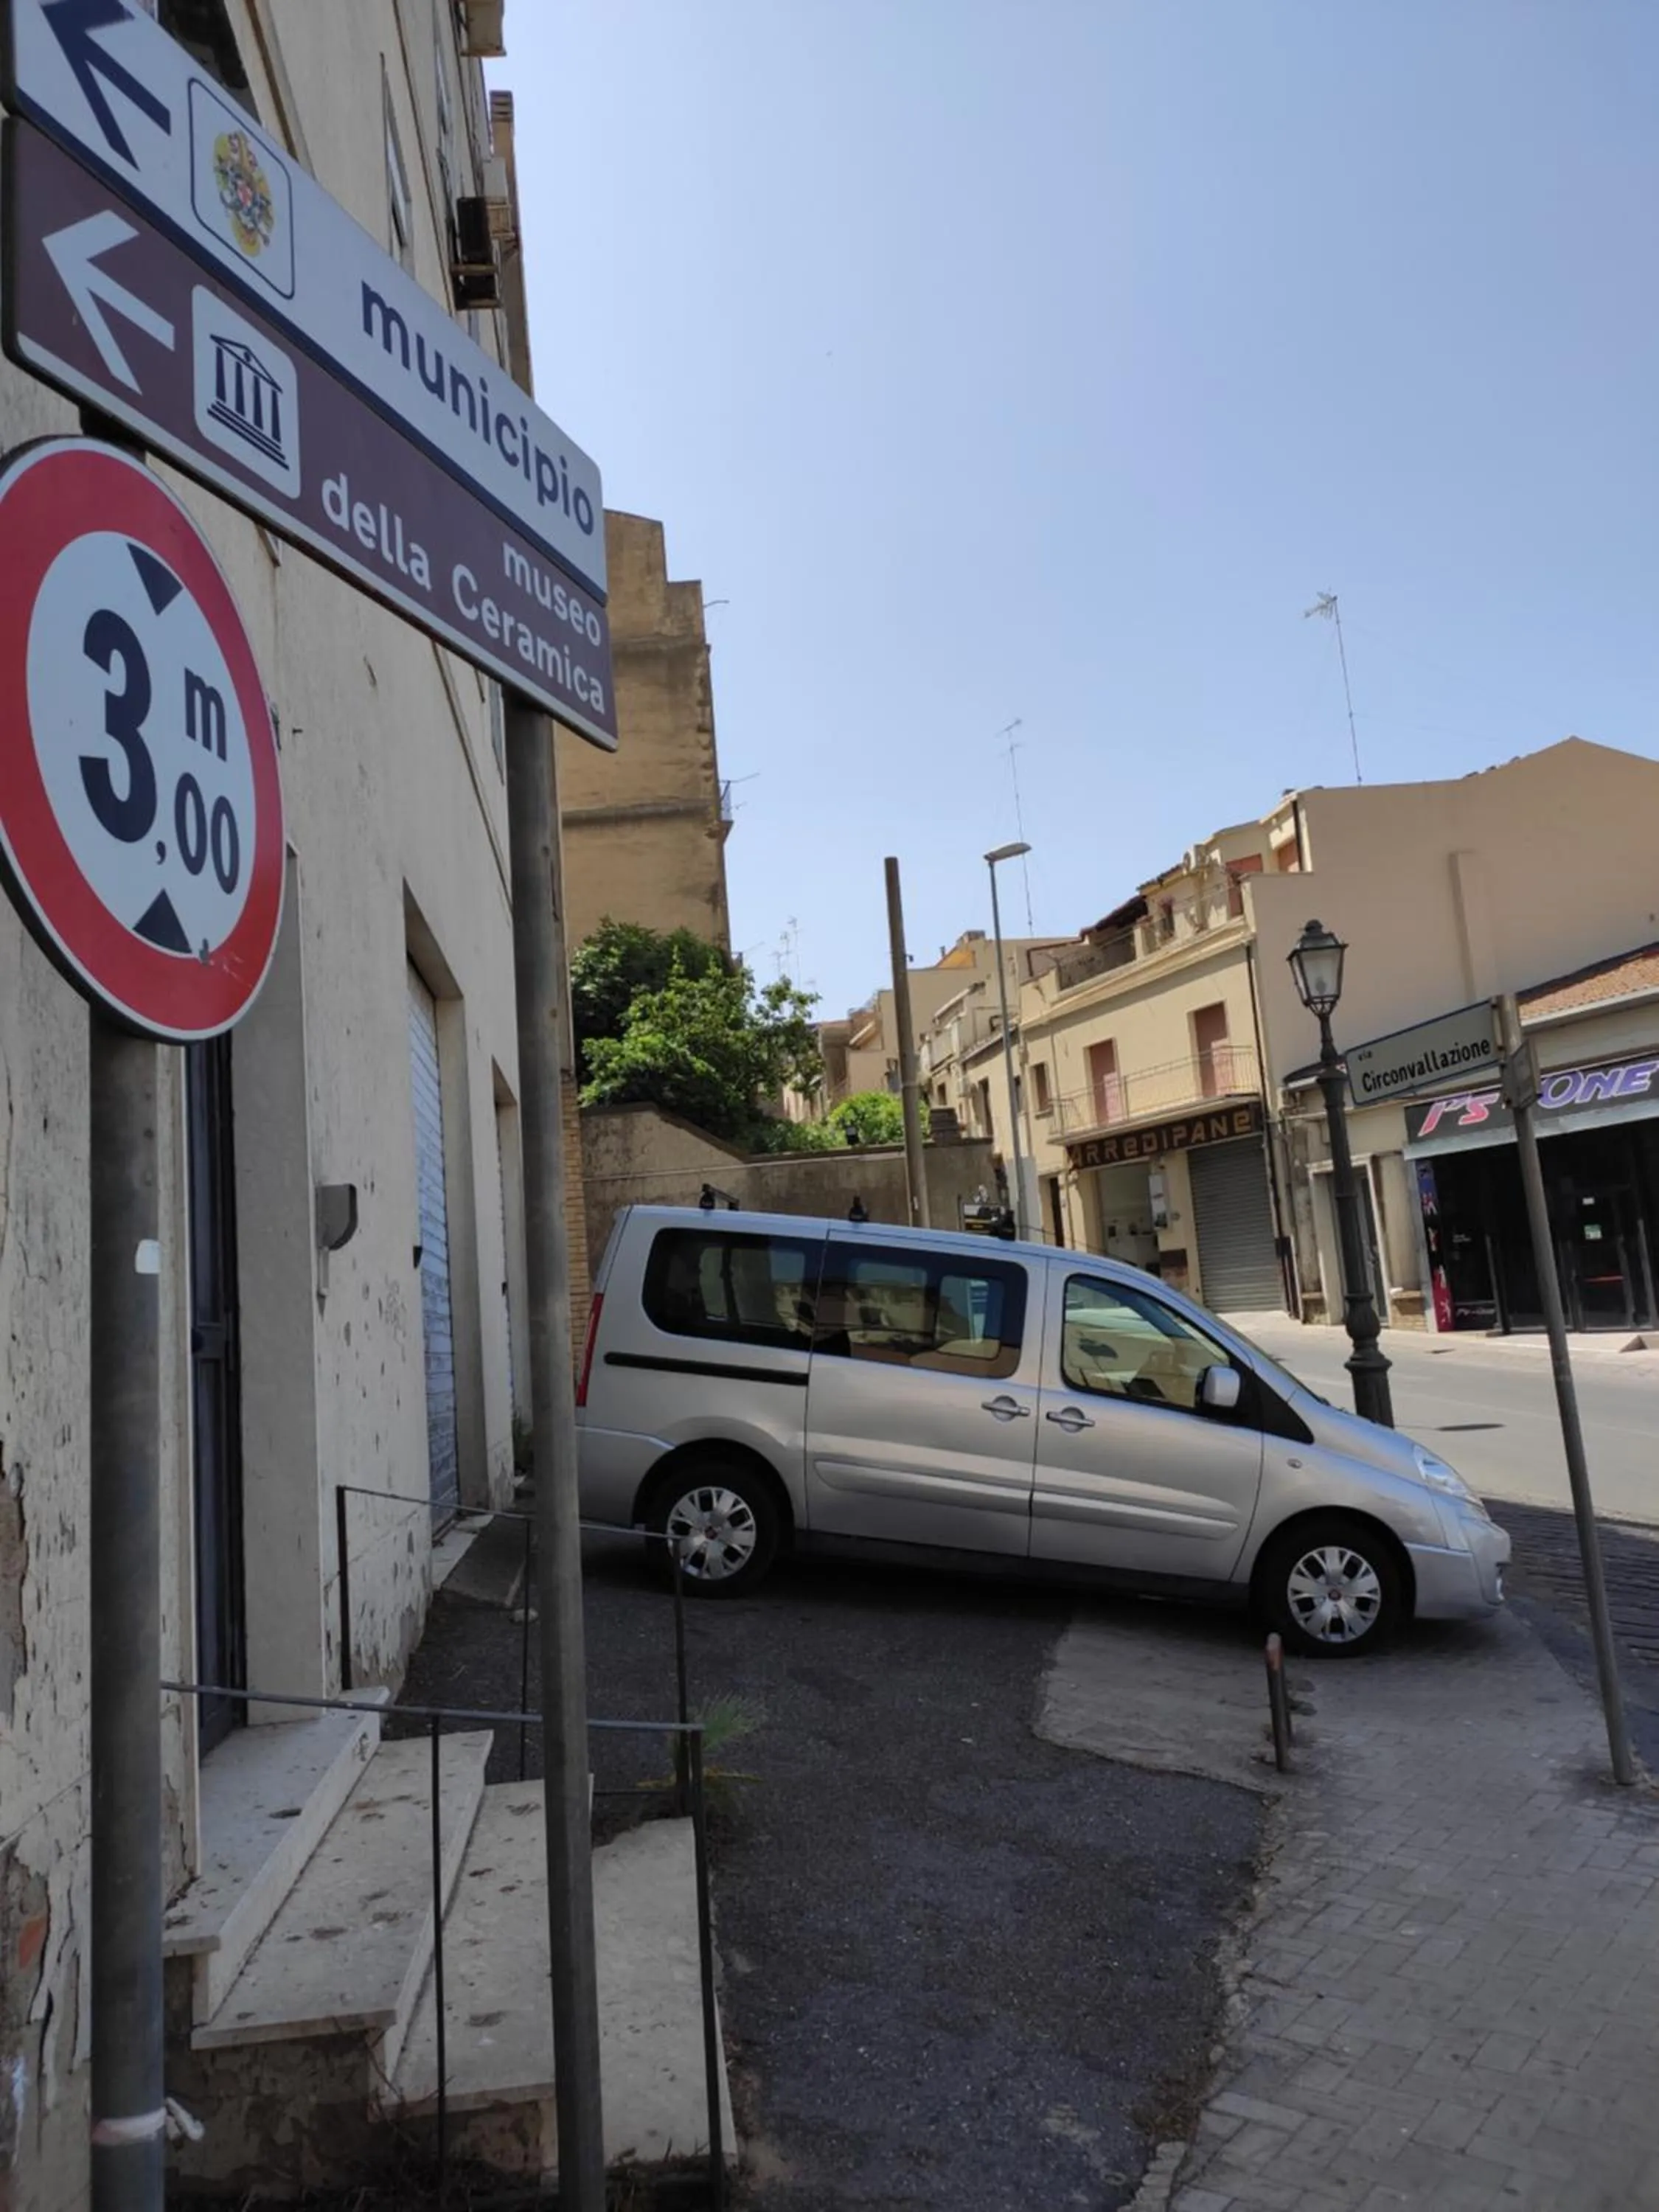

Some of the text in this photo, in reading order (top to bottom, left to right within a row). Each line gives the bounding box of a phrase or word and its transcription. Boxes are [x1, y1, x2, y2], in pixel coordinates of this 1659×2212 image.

[361, 279, 594, 537] municipio
[321, 472, 605, 714] della Ceramica
[502, 541, 601, 647] museo
[184, 667, 227, 762] m
[1362, 1039, 1491, 1093] Circonvallazione
